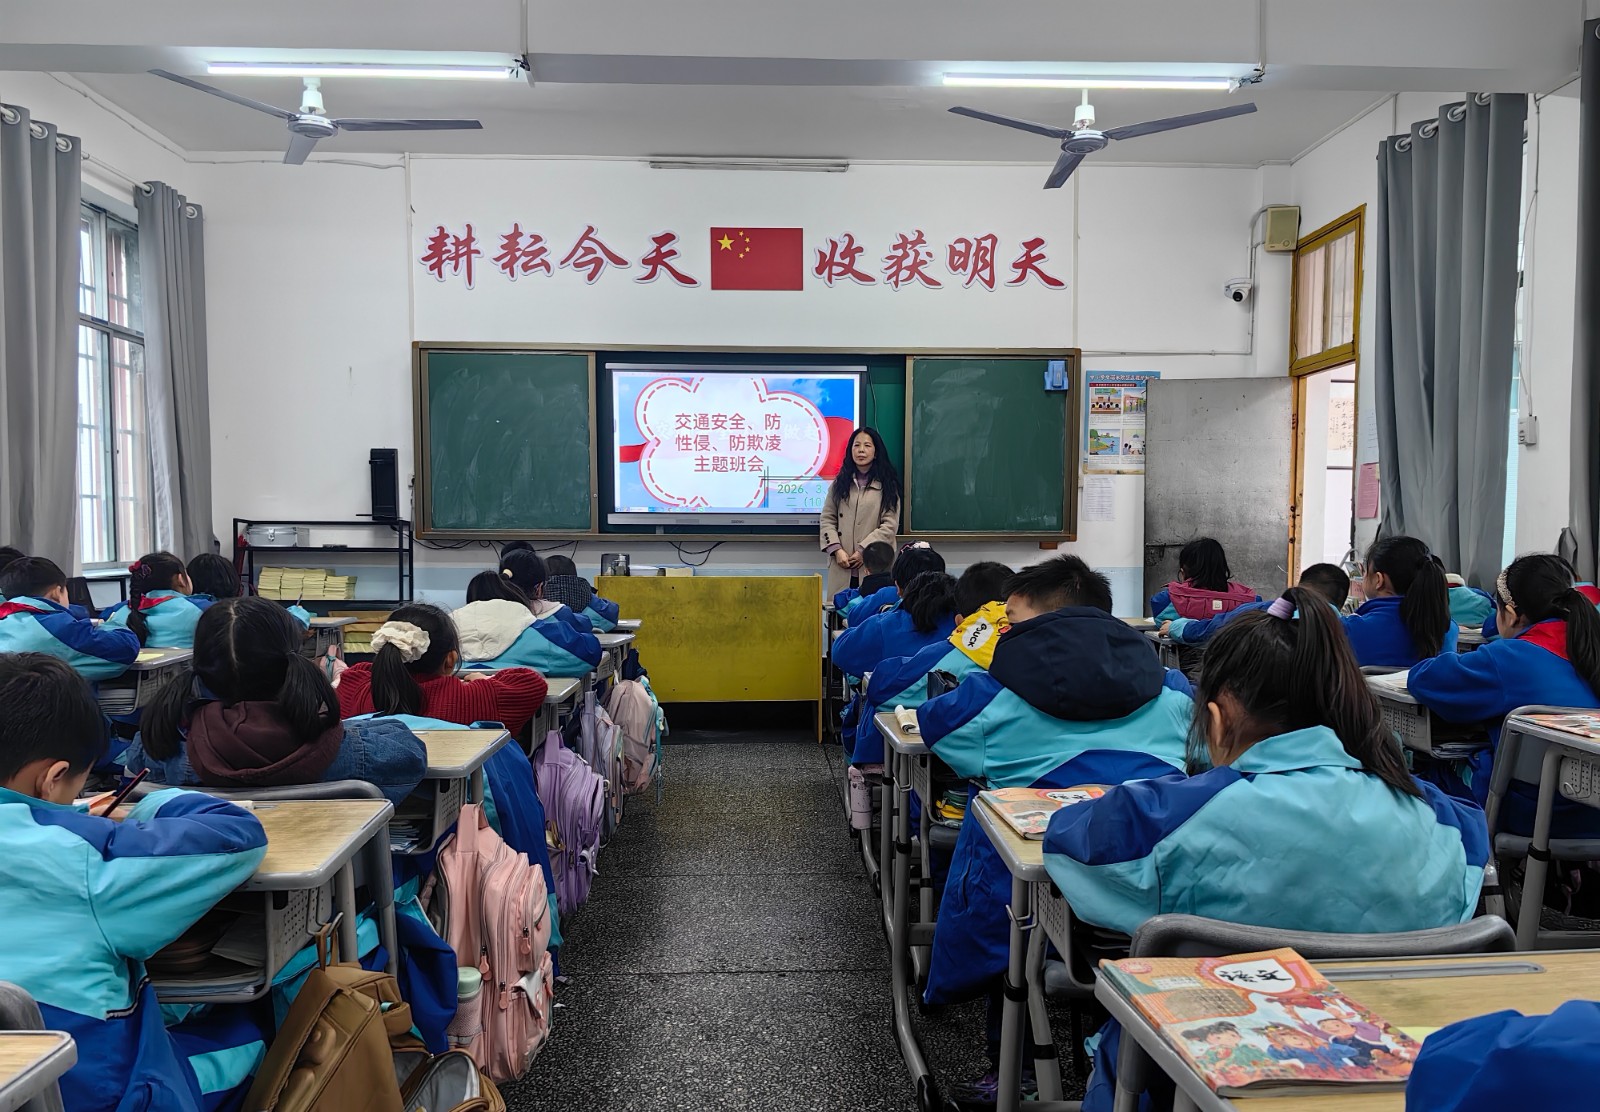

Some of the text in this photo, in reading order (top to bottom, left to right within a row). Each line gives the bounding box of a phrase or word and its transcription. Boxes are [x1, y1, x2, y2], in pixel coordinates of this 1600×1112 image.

[421, 224, 1064, 288] 耕耘今天 收获明天
[675, 413, 781, 430] 交通安全、防
[675, 434, 781, 452] 性侵、防欺凌
[694, 455, 764, 473] 主题班会
[1219, 969, 1292, 983] 语文
